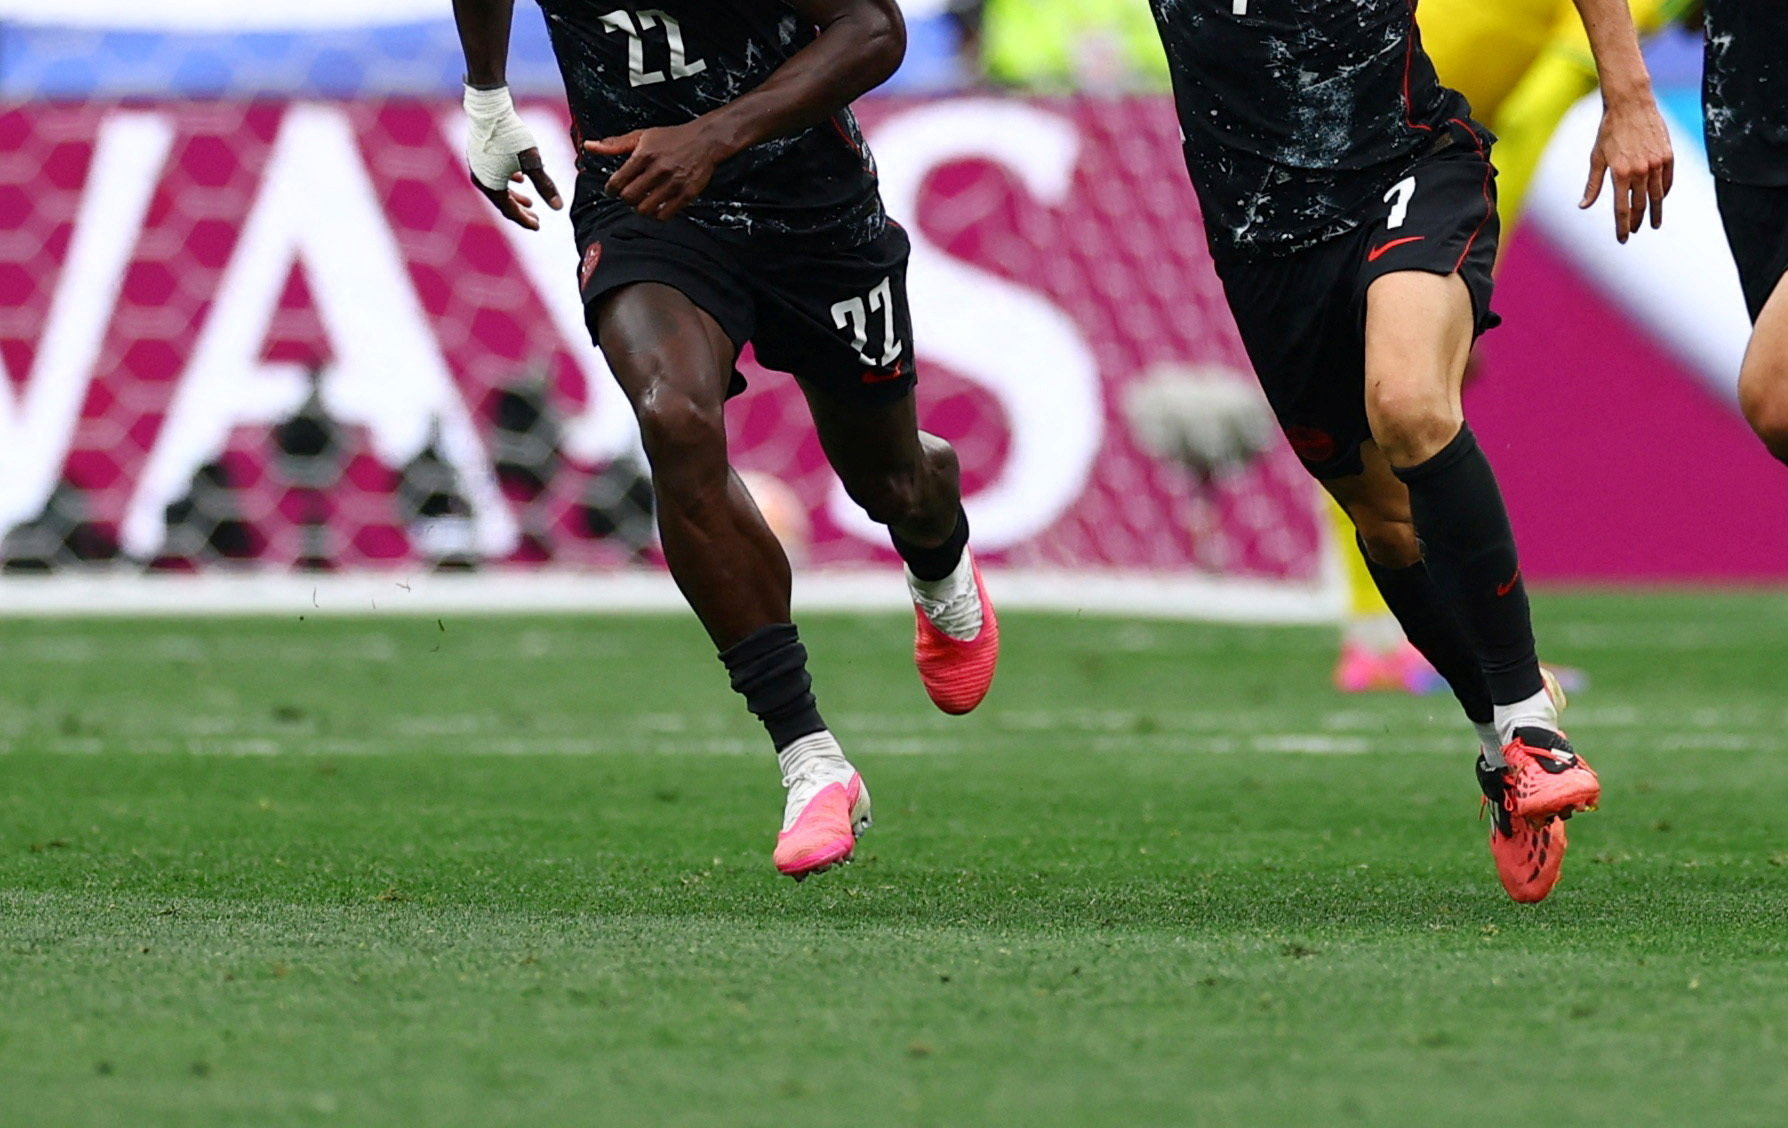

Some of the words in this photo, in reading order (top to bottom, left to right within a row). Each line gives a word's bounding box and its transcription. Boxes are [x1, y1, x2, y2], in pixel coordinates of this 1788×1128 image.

[600, 8, 707, 88] 22
[1382, 175, 1417, 229] 7
[830, 275, 903, 367] 22
